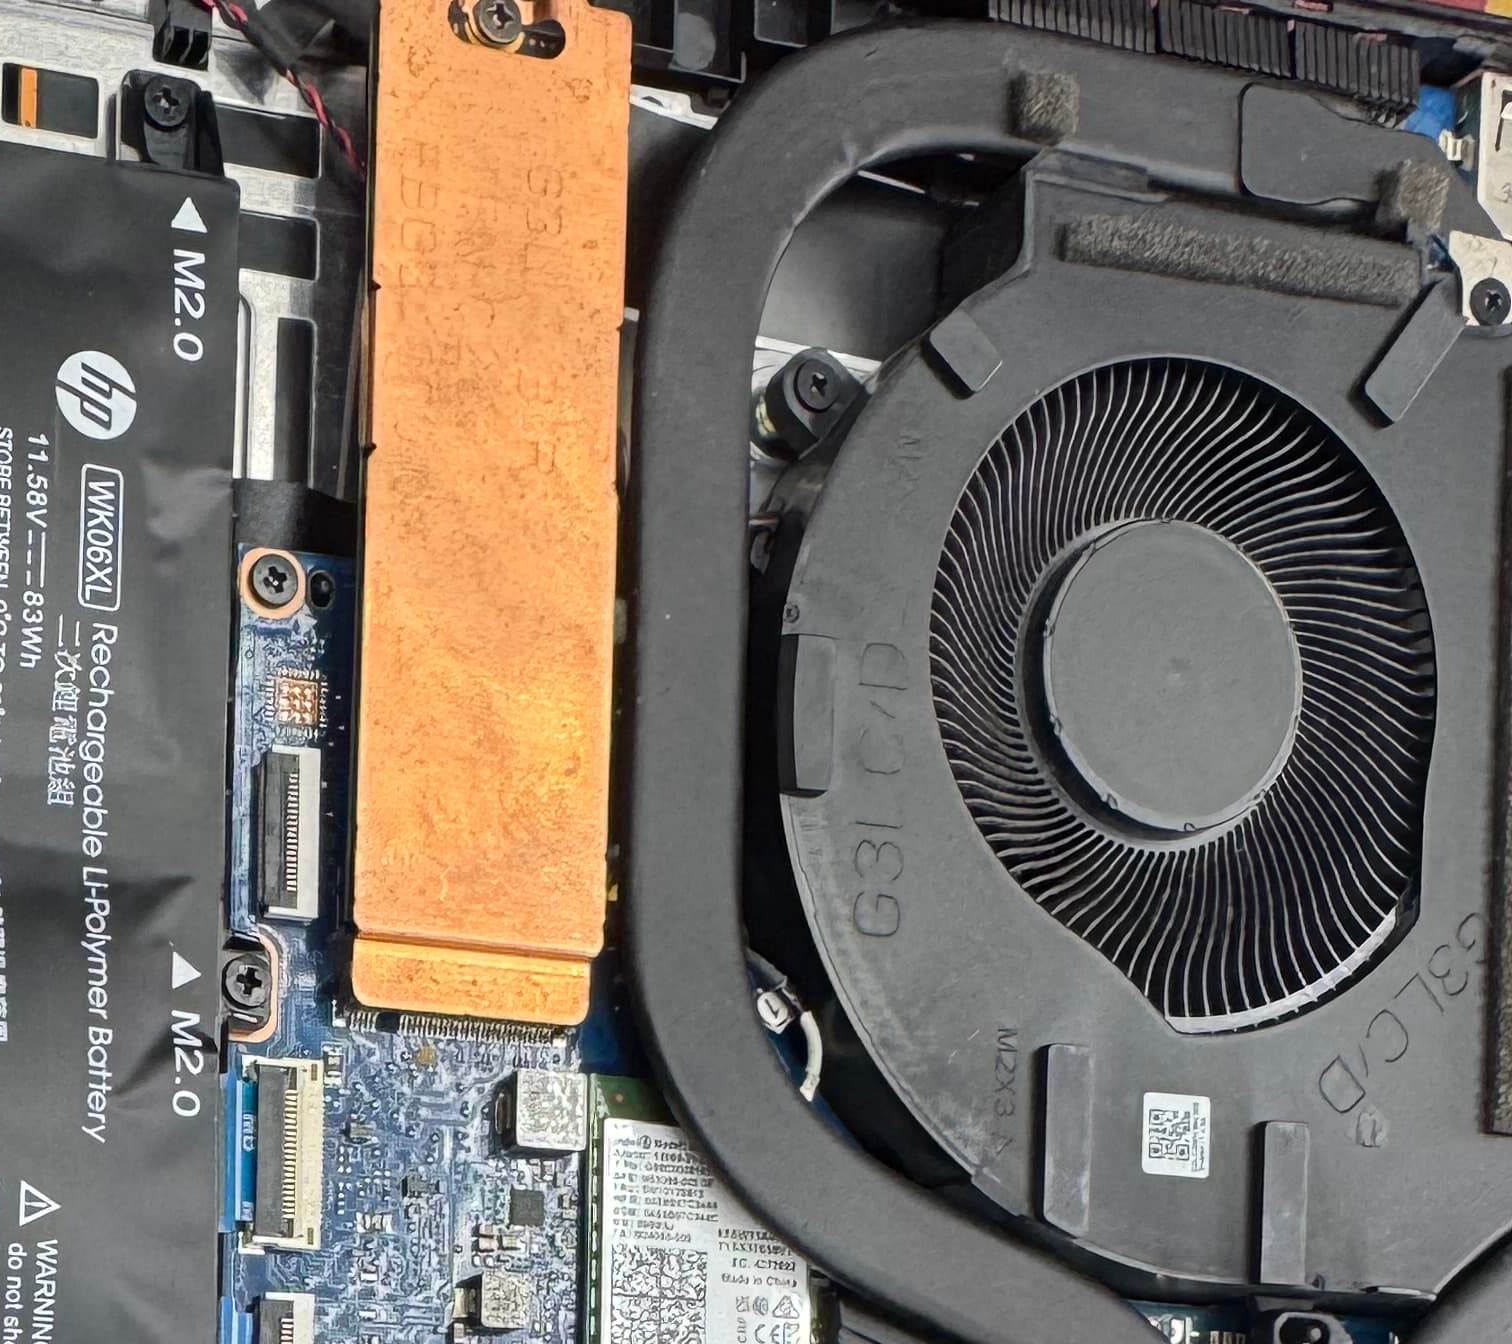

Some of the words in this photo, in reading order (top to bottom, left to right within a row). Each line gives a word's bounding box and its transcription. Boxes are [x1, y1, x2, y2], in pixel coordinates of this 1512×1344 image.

[173, 249, 205, 361] M2.0
[85, 479, 115, 602] WK06XL
[79, 623, 118, 858] Rechargeable
[81, 867, 112, 1019] Li-Polymer
[82, 1026, 113, 1143] Battery
[171, 1010, 204, 1116] M2.0
